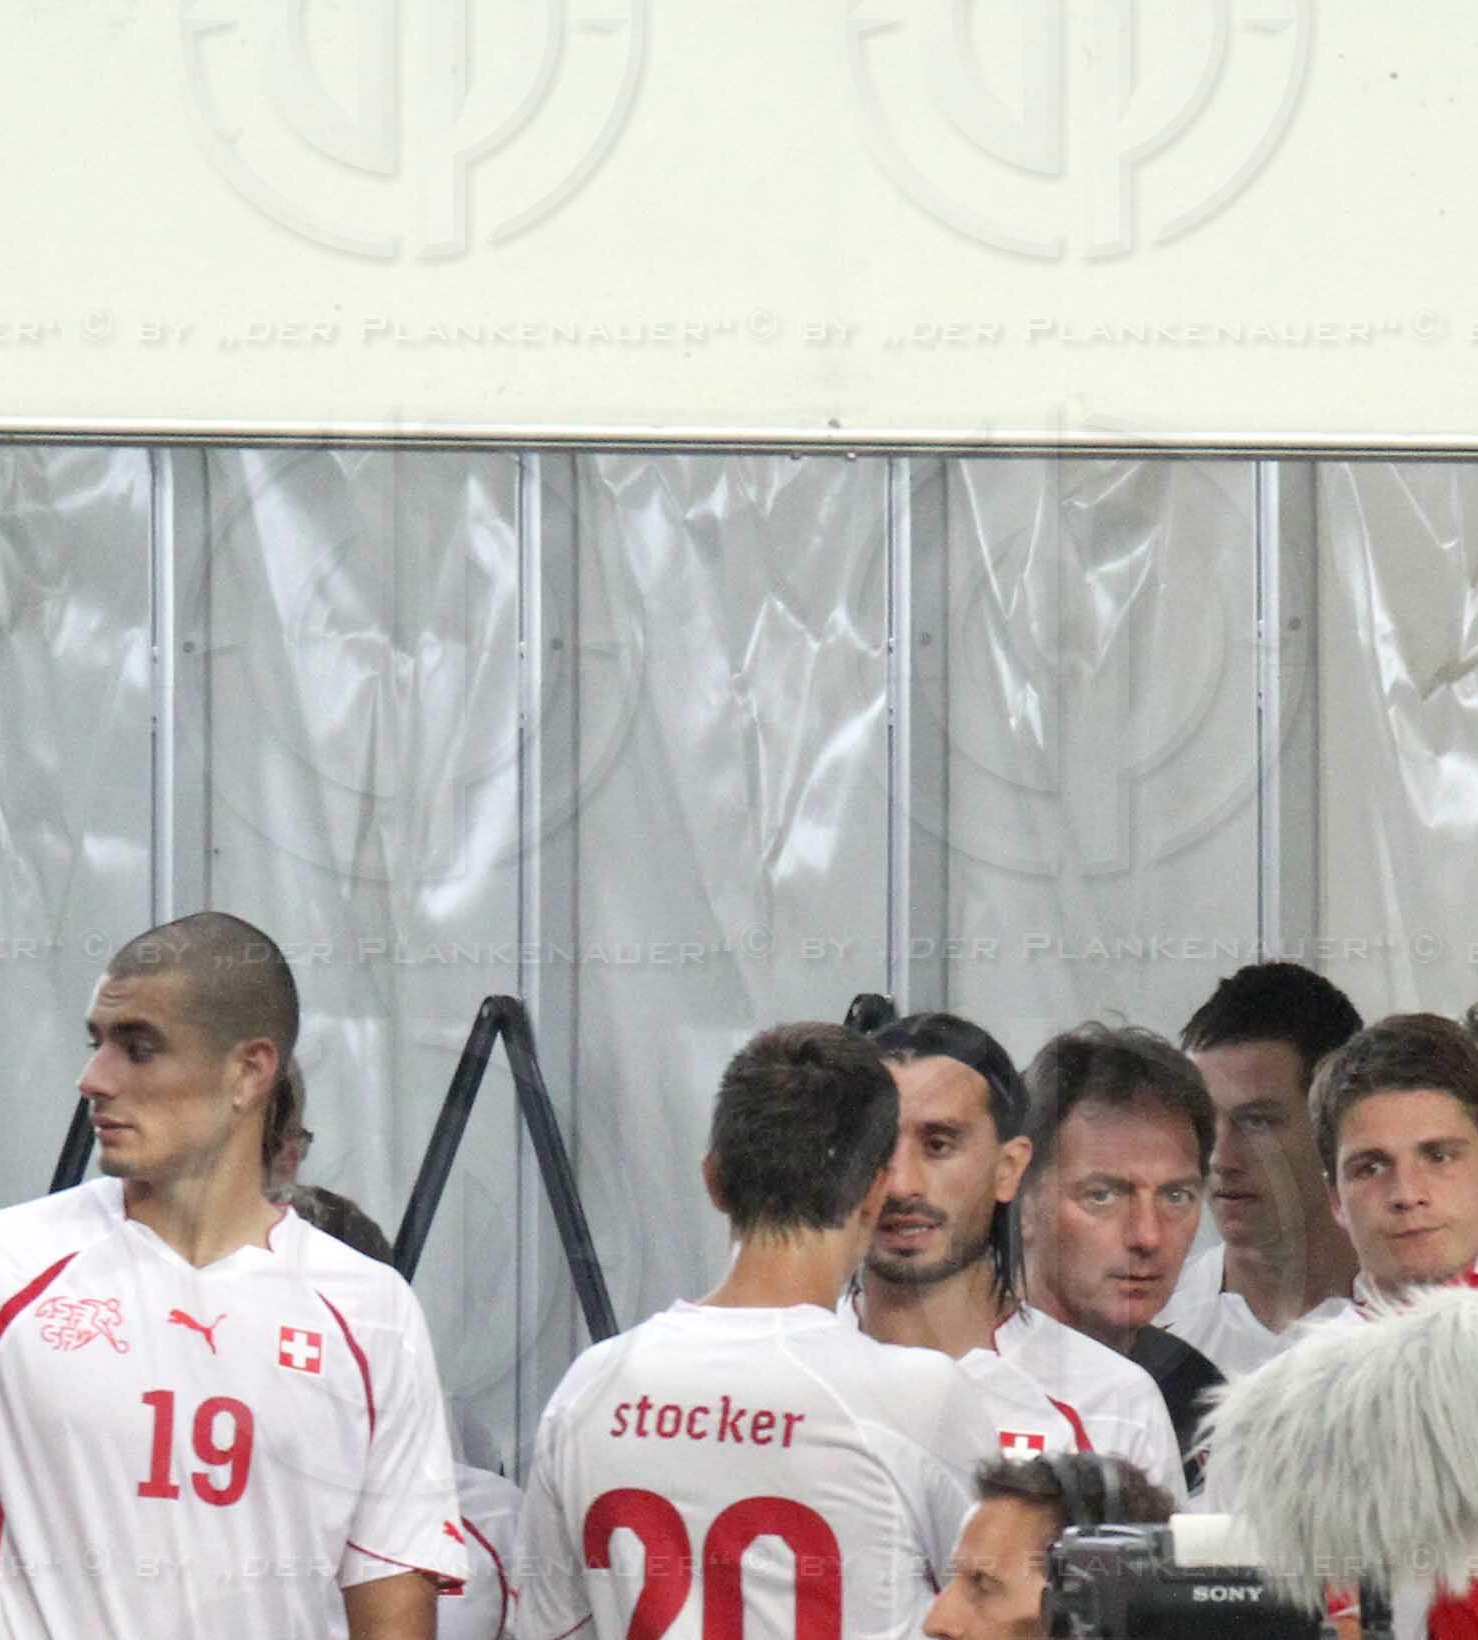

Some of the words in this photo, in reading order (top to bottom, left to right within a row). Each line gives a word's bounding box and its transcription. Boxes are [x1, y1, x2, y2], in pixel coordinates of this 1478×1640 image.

[137, 1389, 255, 1507] 19
[610, 1395, 805, 1448] stocker
[1192, 1584, 1264, 1603] SONY
